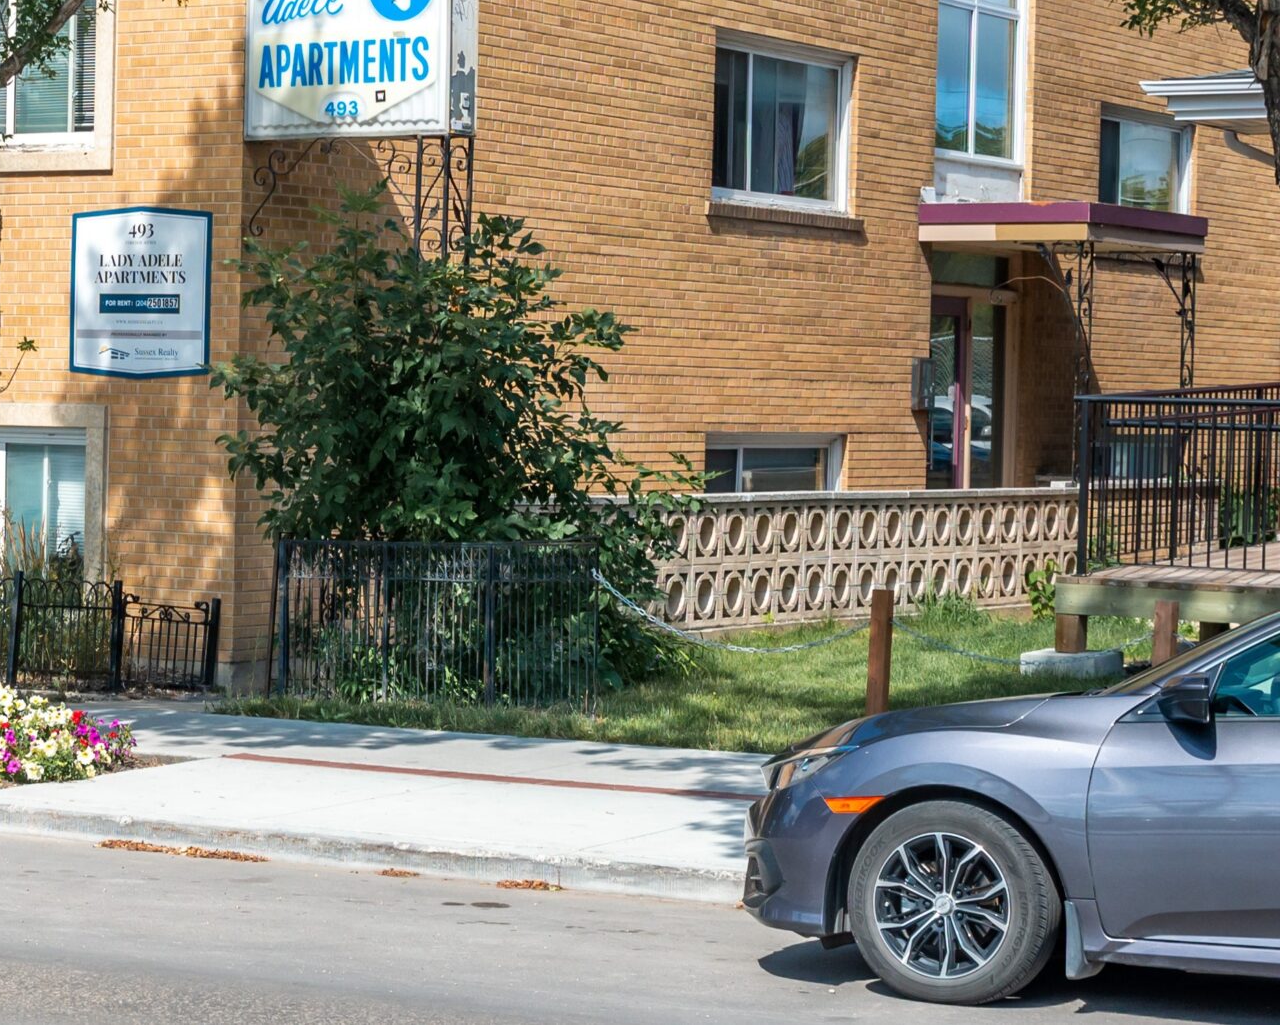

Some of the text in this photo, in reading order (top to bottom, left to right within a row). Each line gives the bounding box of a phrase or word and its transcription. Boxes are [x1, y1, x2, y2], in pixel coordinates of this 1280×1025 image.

[258, 36, 429, 89] APARTMENTS
[325, 101, 359, 117] 493
[128, 223, 154, 238] 493
[100, 254, 183, 267] LADY ADELE
[94, 271, 186, 284] APARTMENTS
[134, 348, 178, 356] Sussex Realty
